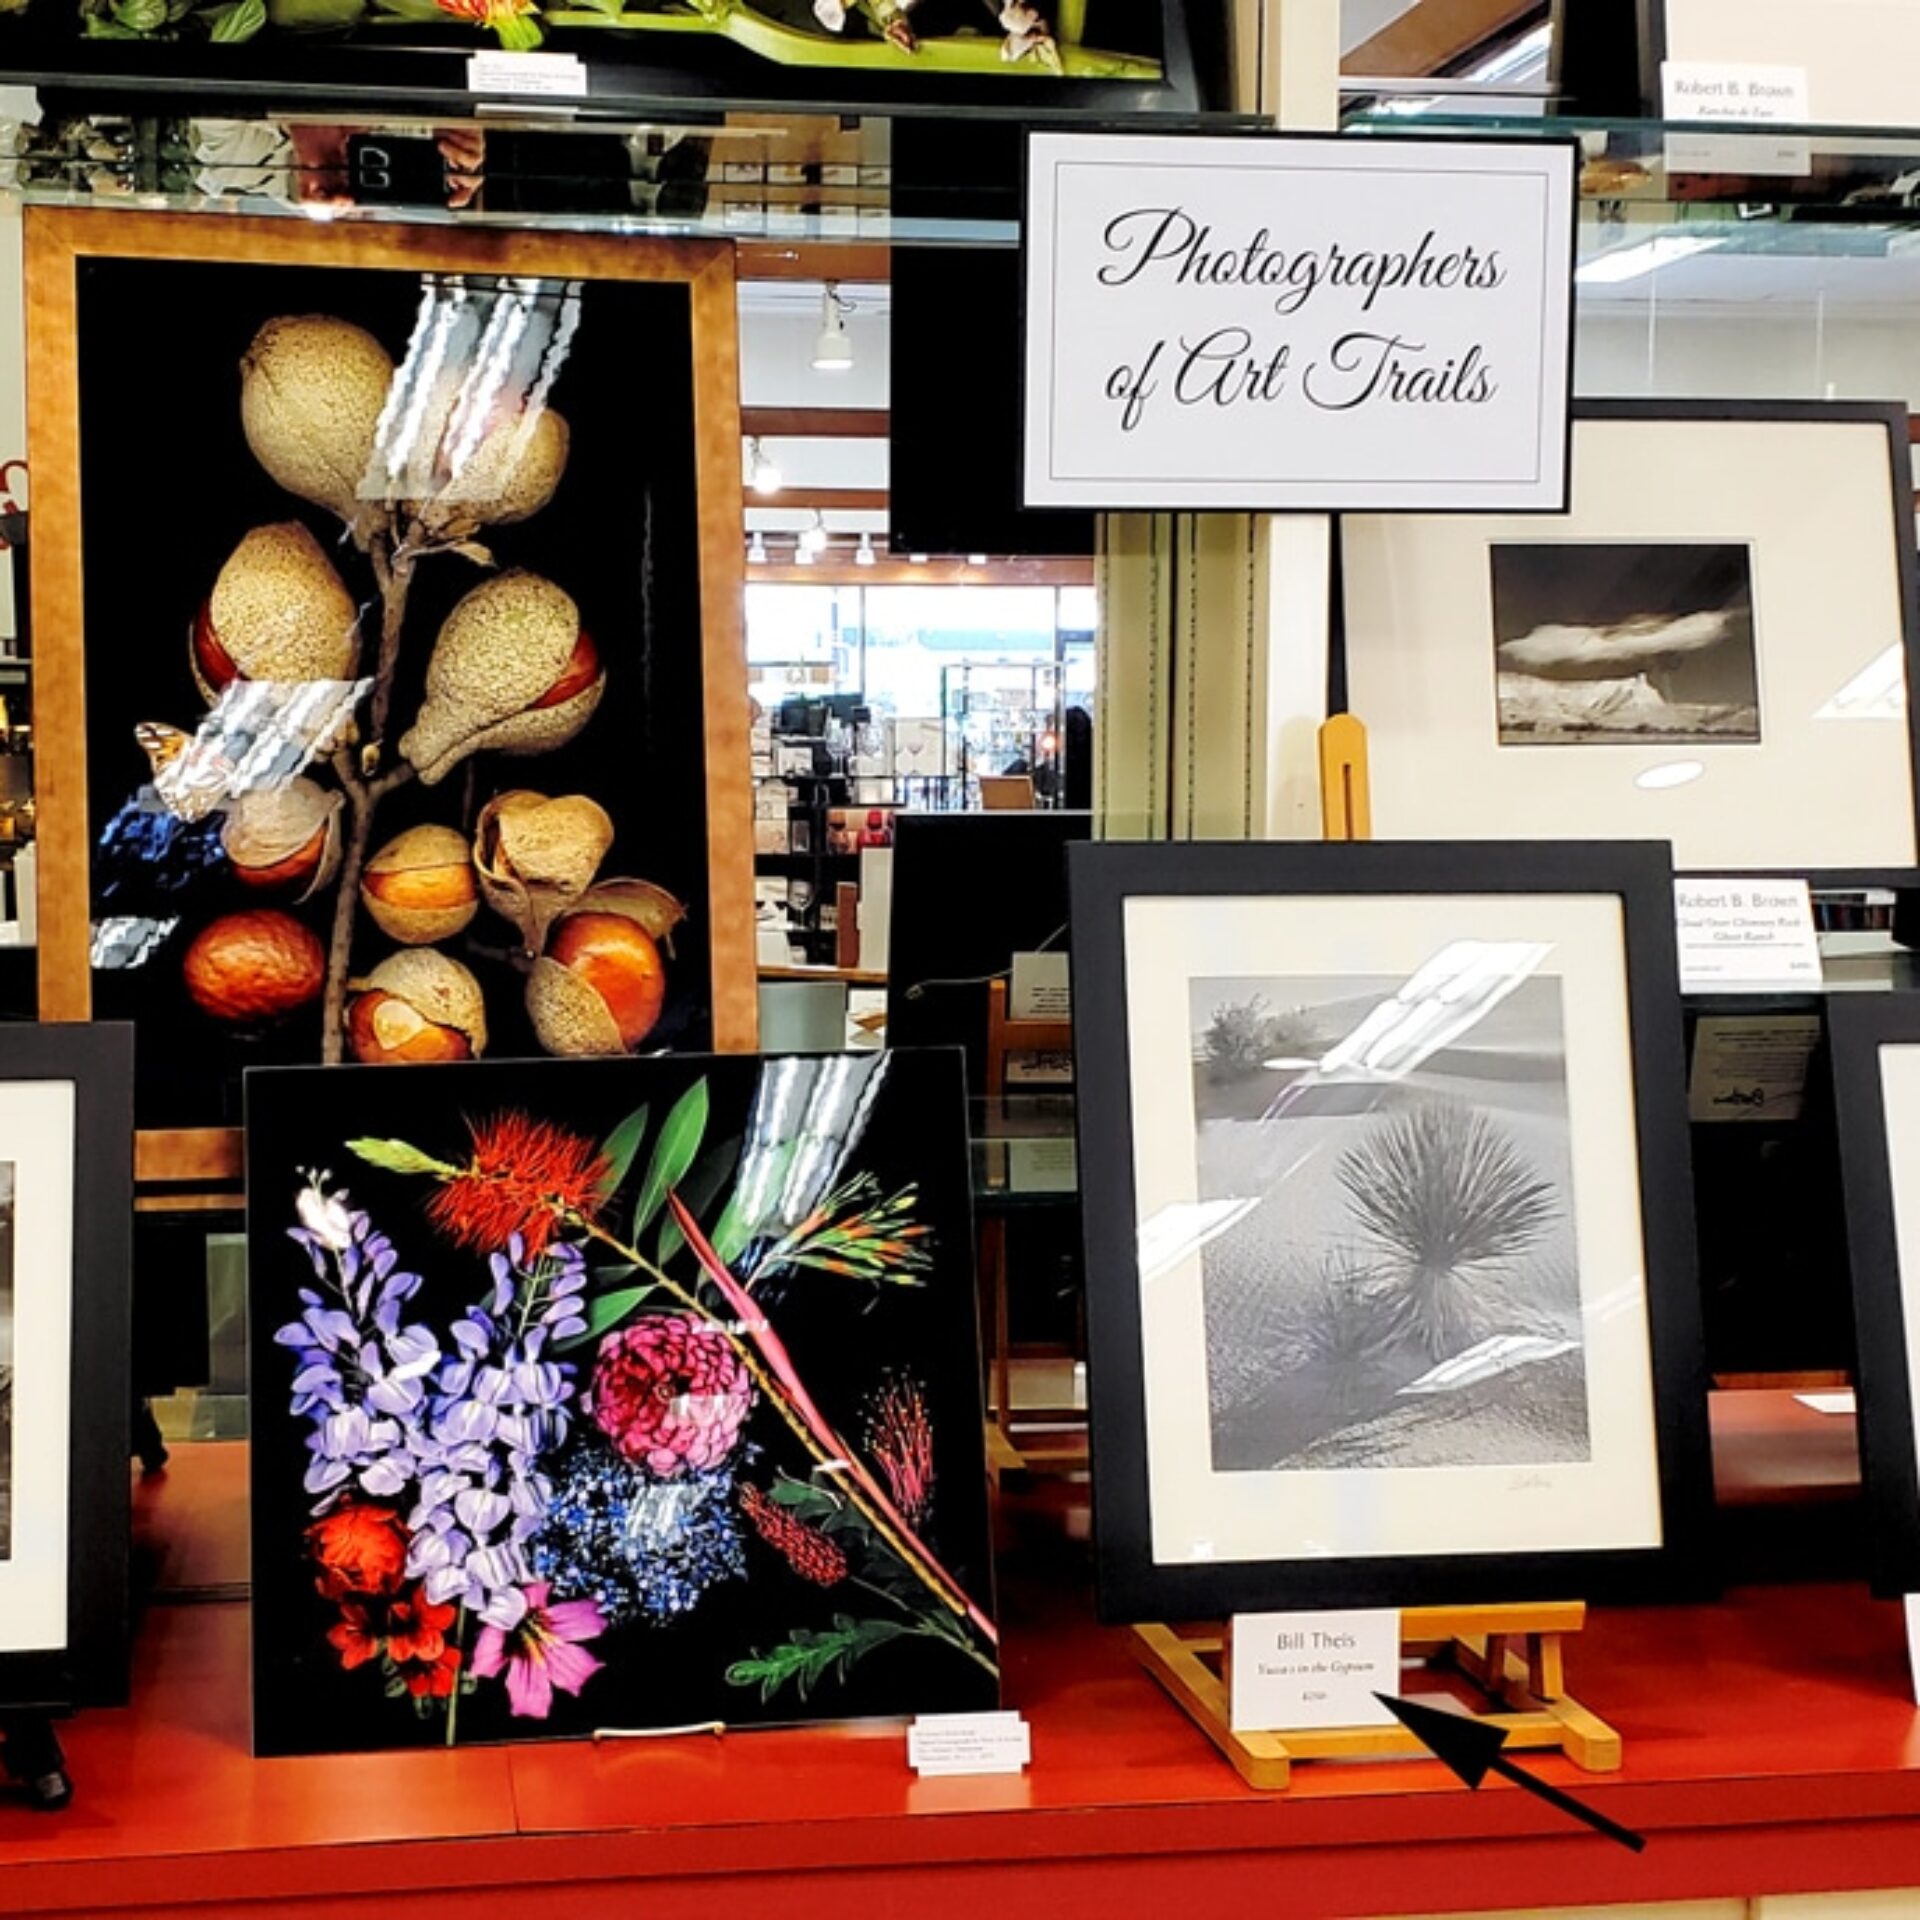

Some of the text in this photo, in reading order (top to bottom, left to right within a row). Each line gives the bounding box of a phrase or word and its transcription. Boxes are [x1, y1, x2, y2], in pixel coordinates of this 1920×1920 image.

[1674, 79, 1723, 96] Robert
[1097, 206, 1507, 315] Photographers
[1105, 327, 1497, 432] of Art Trails
[1679, 893, 1727, 908] Robert
[1277, 1631, 1356, 1650] Bill Theis
